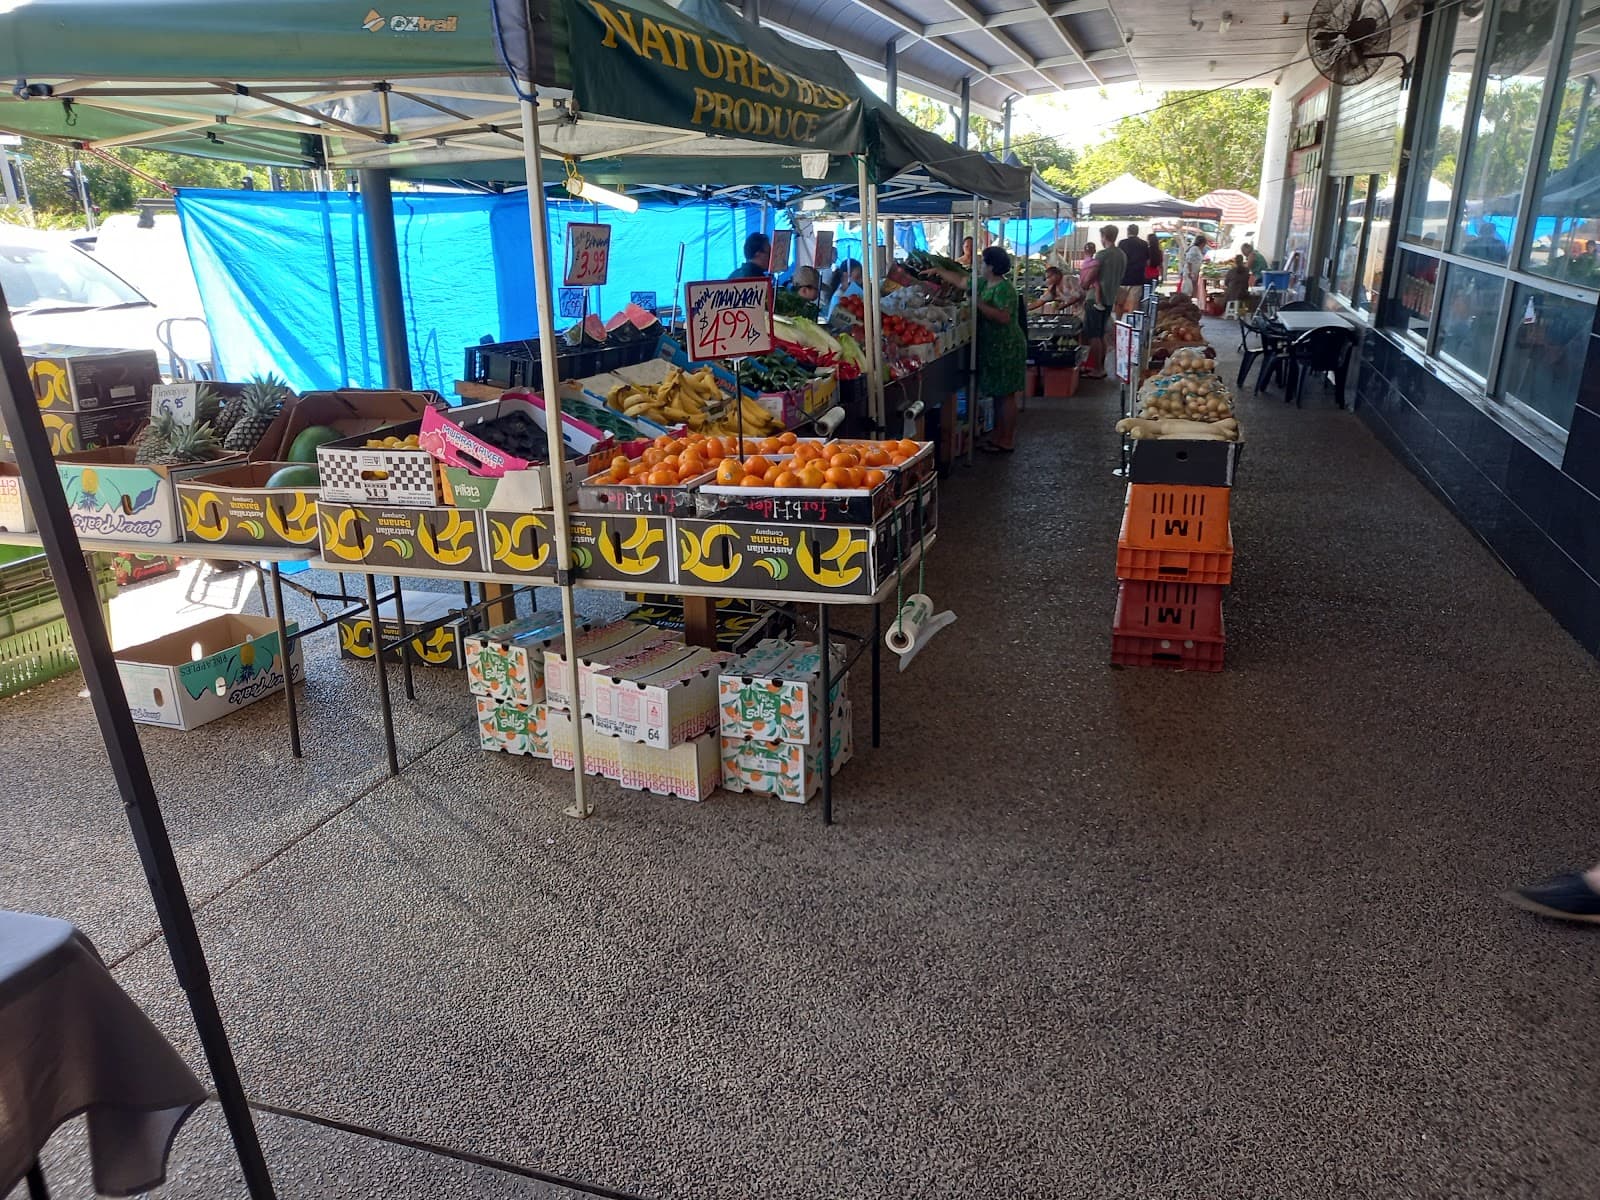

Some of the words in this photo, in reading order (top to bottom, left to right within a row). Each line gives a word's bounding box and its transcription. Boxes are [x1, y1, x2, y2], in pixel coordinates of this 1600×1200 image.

[589, 0, 790, 98] NATURES
[690, 87, 820, 143] PRODUCE
[441, 424, 478, 451] MURRAY
[477, 446, 504, 468] RIVER
[230, 502, 260, 511] Banana
[229, 510, 264, 518] Australian
[73, 514, 116, 533] Peaks
[116, 519, 161, 537] Seven
[378, 518, 412, 527] Banana
[376, 527, 415, 536] Australian
[755, 528, 784, 536] Company
[750, 535, 789, 545] Banana
[747, 545, 793, 555] Australian
[179, 654, 228, 676] PINEAPPLES
[229, 677, 266, 704] Peaks
[648, 728, 659, 740] 64
